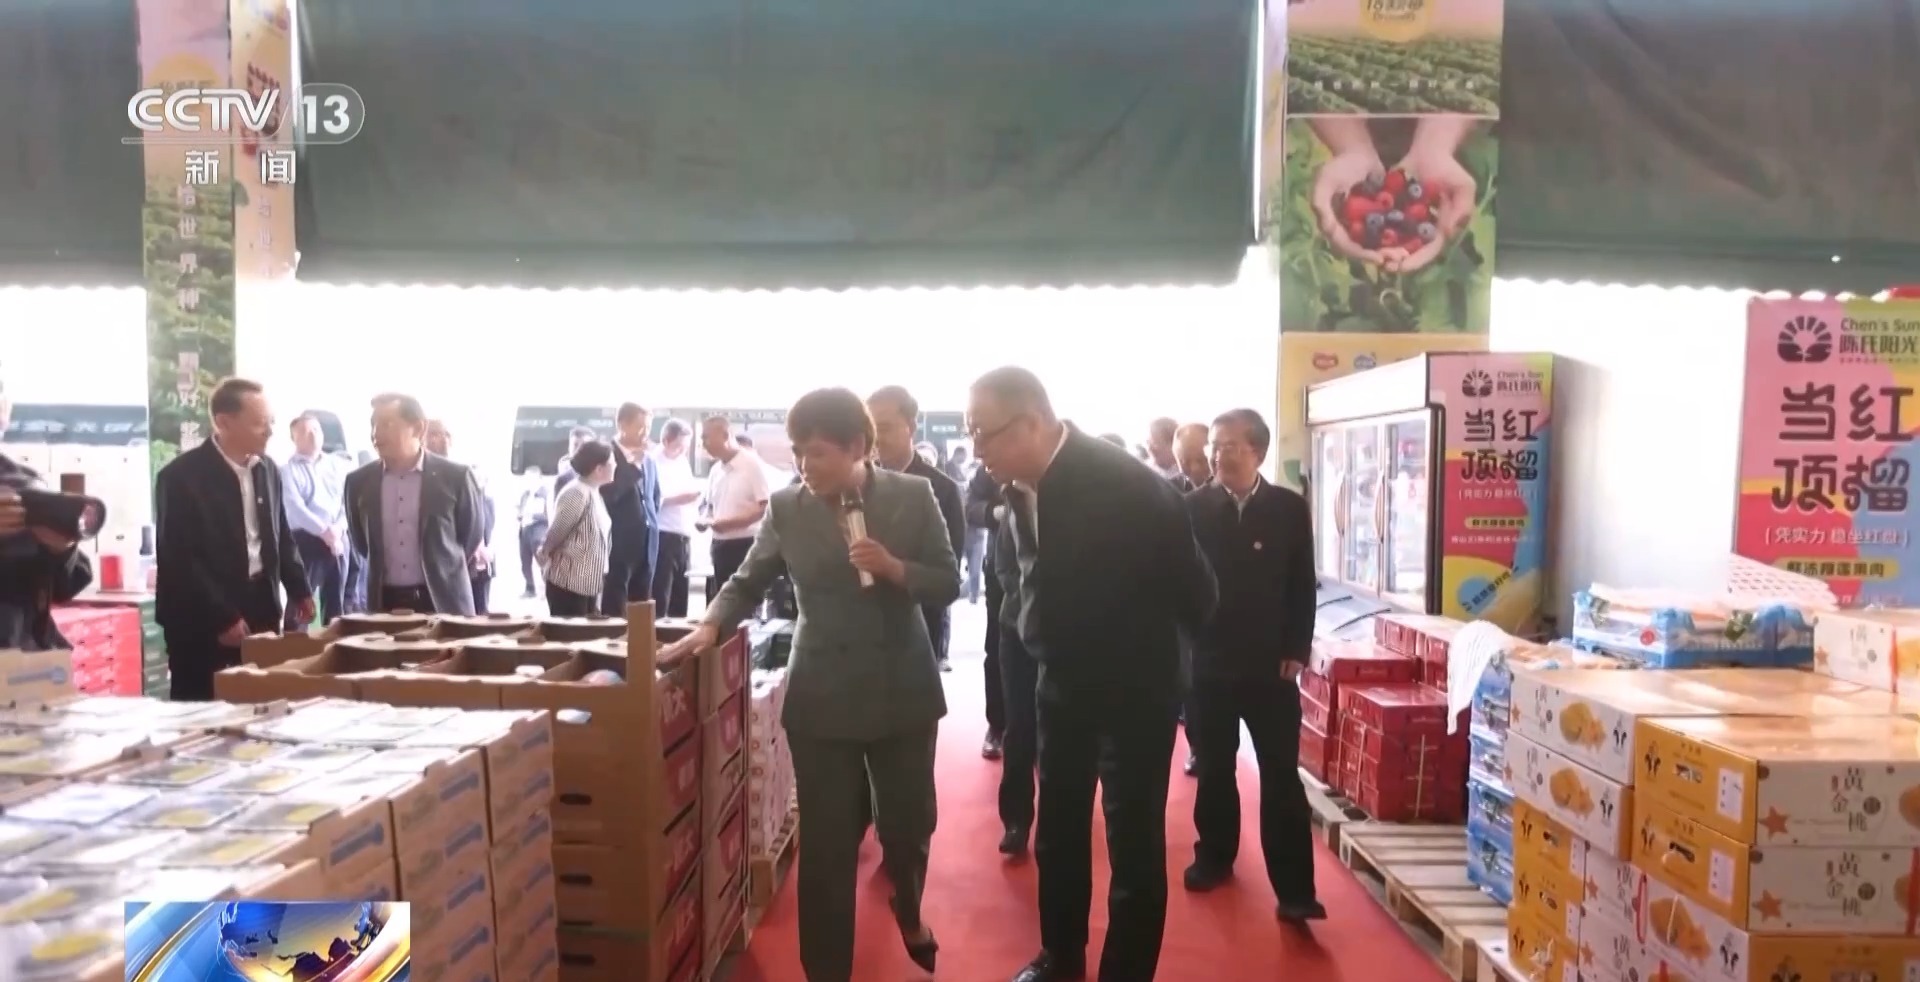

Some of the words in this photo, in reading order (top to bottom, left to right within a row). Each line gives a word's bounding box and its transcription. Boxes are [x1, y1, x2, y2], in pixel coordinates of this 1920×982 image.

[1840, 317, 1889, 331] Chen's
[1839, 335, 1919, 354] 陈氏阳光
[1463, 408, 1539, 442] 当红
[1780, 382, 1914, 442] 当红
